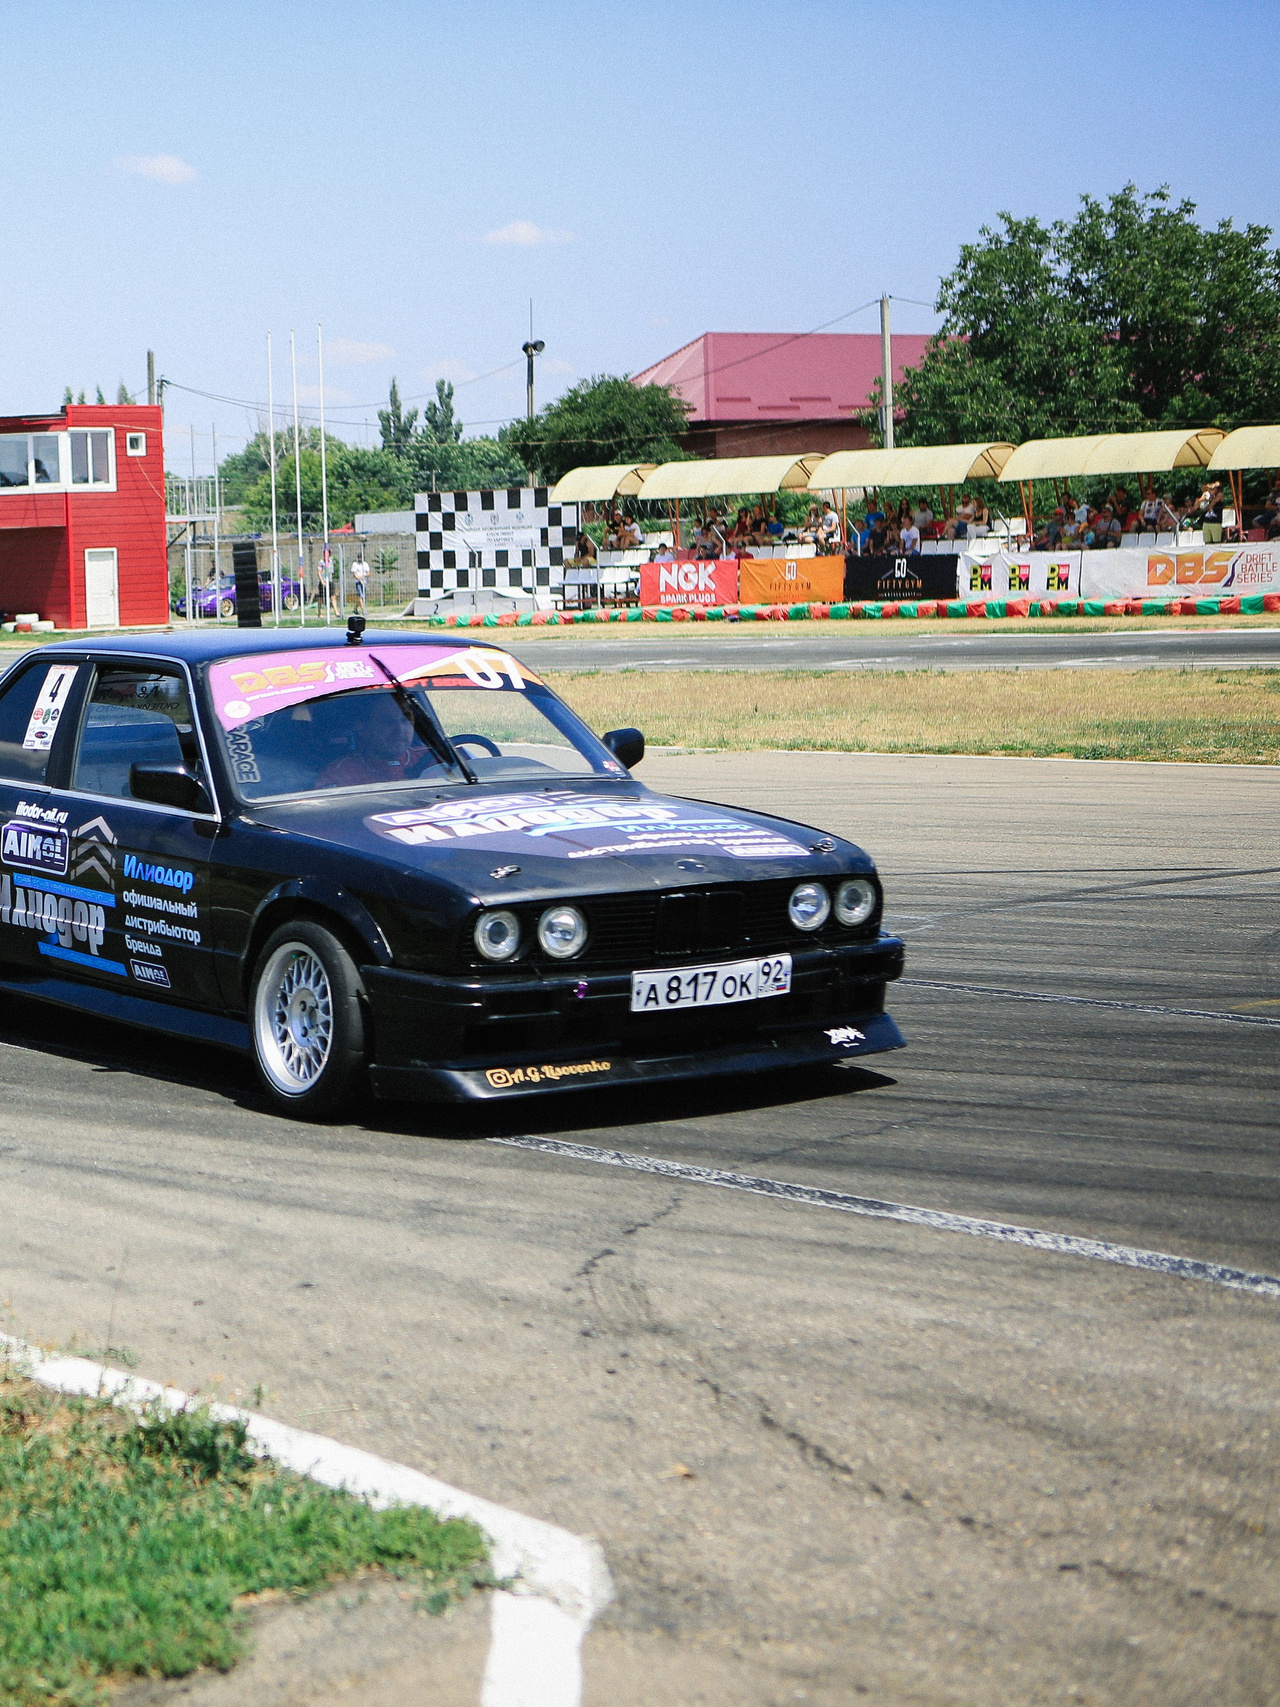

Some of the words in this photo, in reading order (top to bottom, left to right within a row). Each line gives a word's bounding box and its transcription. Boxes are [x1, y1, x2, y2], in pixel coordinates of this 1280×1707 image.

[1147, 551, 1237, 586] DBS
[1241, 563, 1278, 574] BATTLE
[1246, 553, 1273, 564] DRIFT
[659, 561, 717, 592] NGK
[877, 579, 903, 590] FIFTY
[905, 579, 922, 589] GYM
[1237, 573, 1273, 584] SERIES
[433, 603, 439, 615] 2
[660, 593, 688, 604] SPARK
[688, 592, 717, 603] PLUGS
[230, 661, 326, 694] DBS
[453, 649, 527, 690] 07
[49, 674, 65, 703] 4
[15, 801, 69, 824] iliodor-oil.ru
[3, 829, 65, 866] AIMOL
[123, 854, 194, 895] Илиодор
[123, 889, 198, 919] официальный
[125, 914, 201, 946] дистрибьютор
[125, 934, 163, 957] бренда
[761, 960, 784, 985] 92
